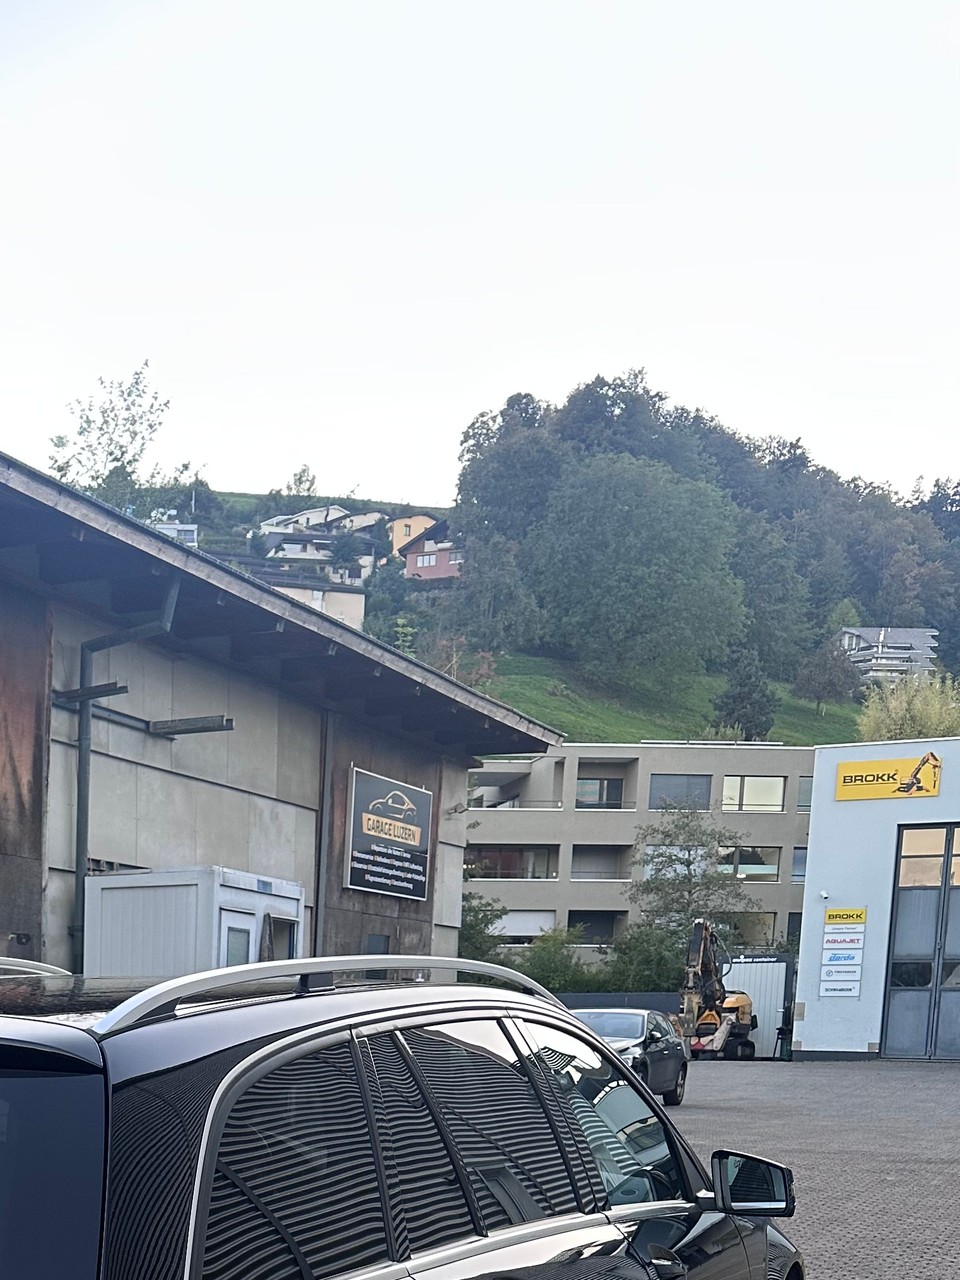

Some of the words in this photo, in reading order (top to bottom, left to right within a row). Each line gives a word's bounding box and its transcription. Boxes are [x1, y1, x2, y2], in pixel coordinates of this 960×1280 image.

[843, 773, 897, 783] BROKK
[367, 818, 392, 836] GARAGE
[393, 823, 416, 842] LUZERN
